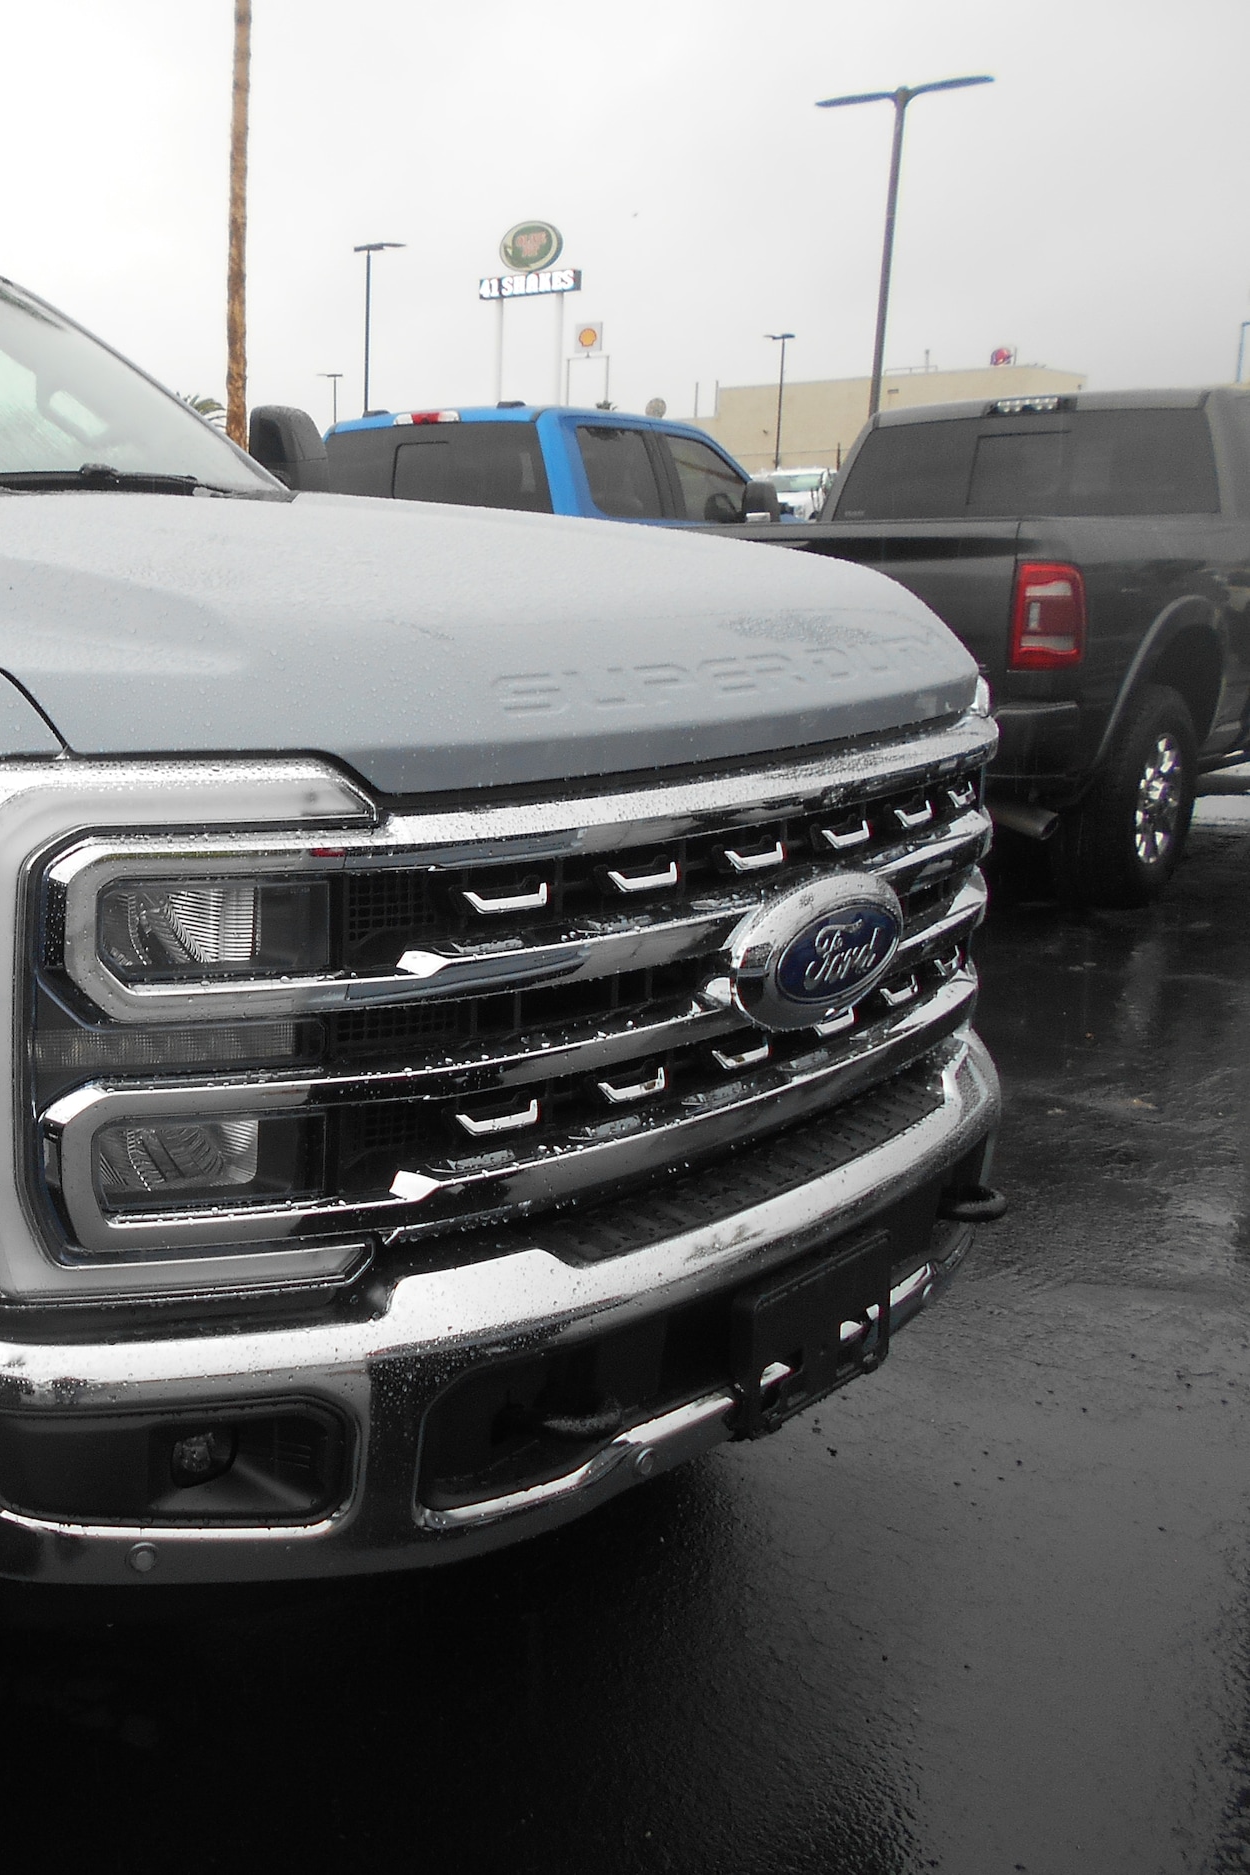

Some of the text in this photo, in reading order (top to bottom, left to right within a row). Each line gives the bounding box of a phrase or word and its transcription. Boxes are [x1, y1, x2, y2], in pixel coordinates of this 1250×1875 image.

[479, 270, 575, 298] 41 SHAKES
[803, 918, 880, 991] Ford
